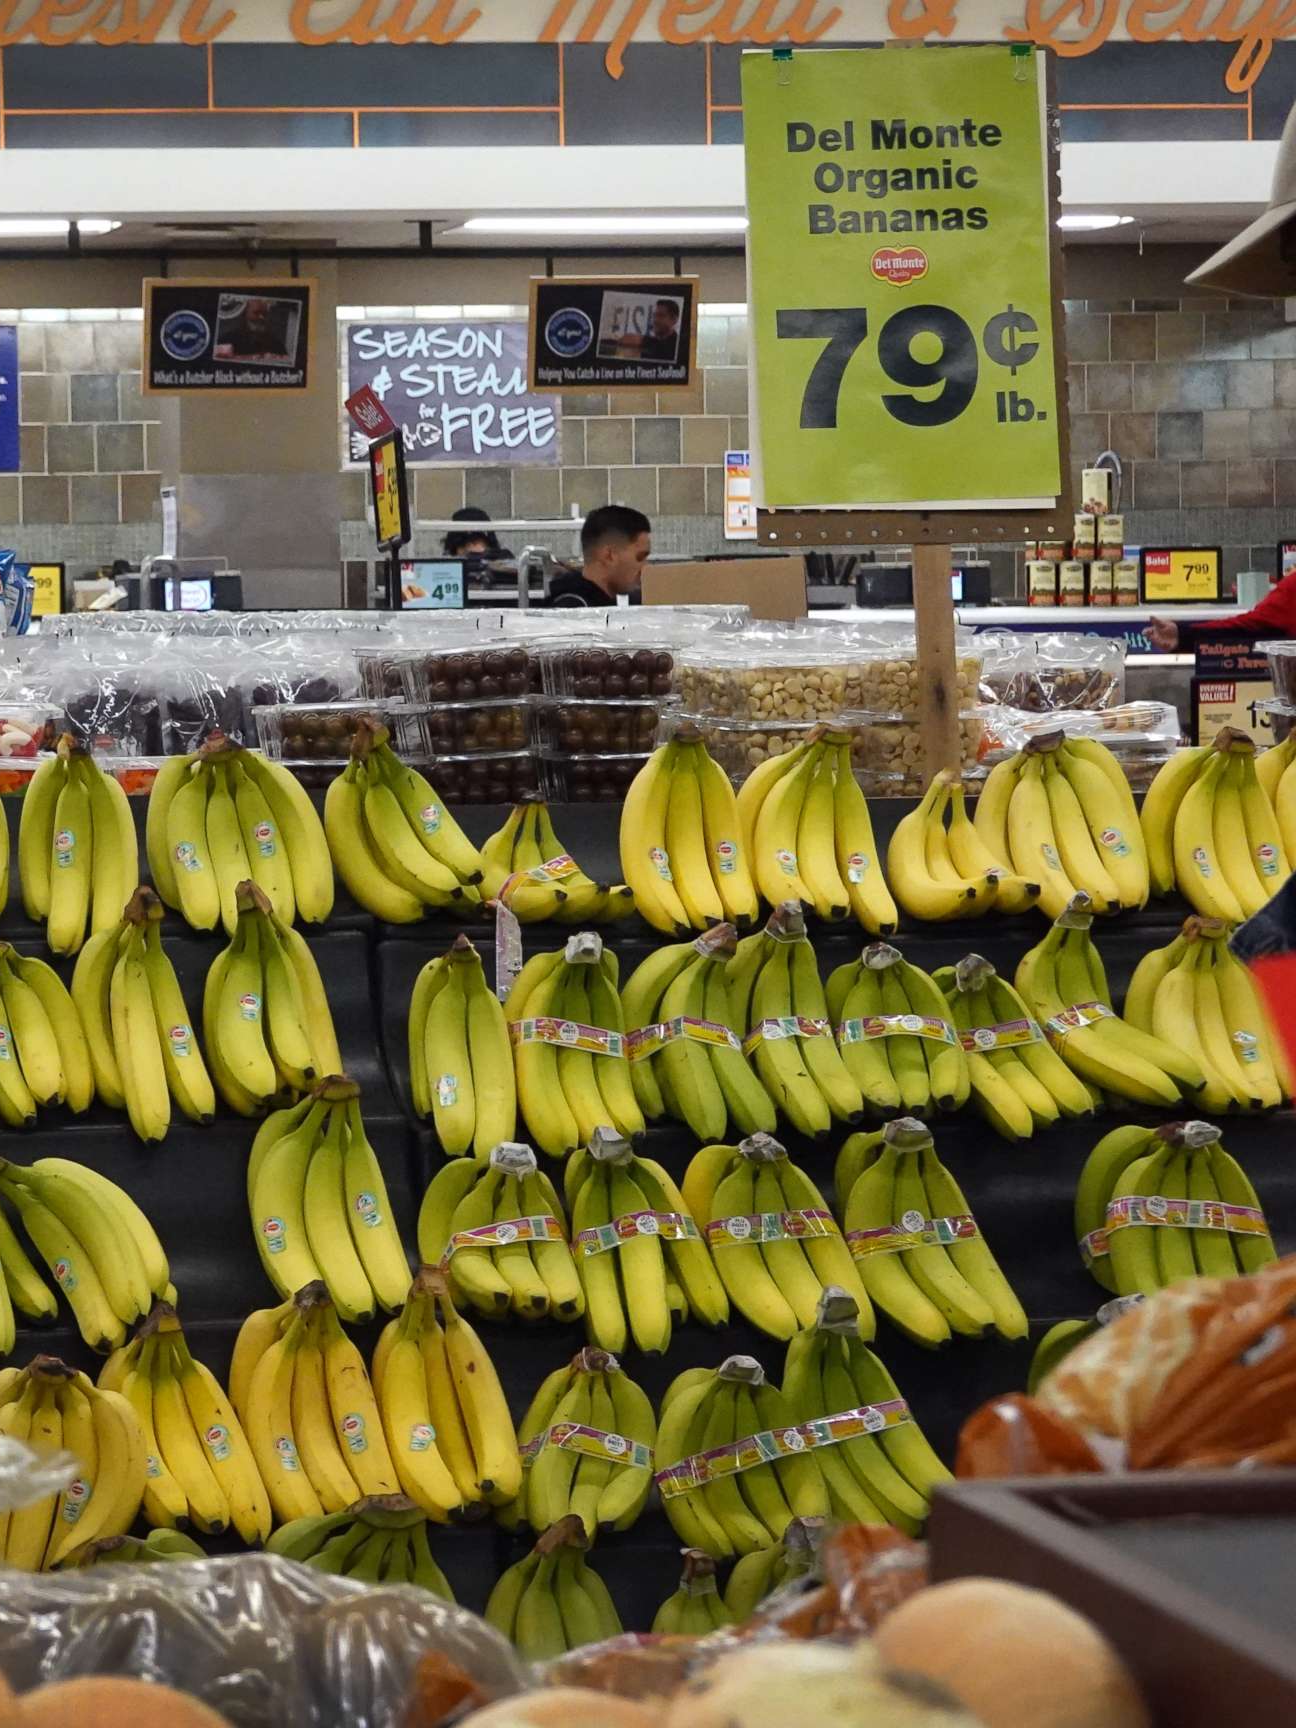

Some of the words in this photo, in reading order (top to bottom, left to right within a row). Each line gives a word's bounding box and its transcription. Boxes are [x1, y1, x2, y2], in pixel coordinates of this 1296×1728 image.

[787, 120, 855, 153] Del
[871, 117, 1002, 150] Monte
[814, 159, 979, 198] Organic
[809, 202, 989, 235] Bananas
[875, 258, 891, 269] Del
[892, 258, 925, 269] Monte
[352, 327, 504, 361] SEASON
[996, 391, 1047, 424] lb.
[441, 402, 557, 454] FREE
